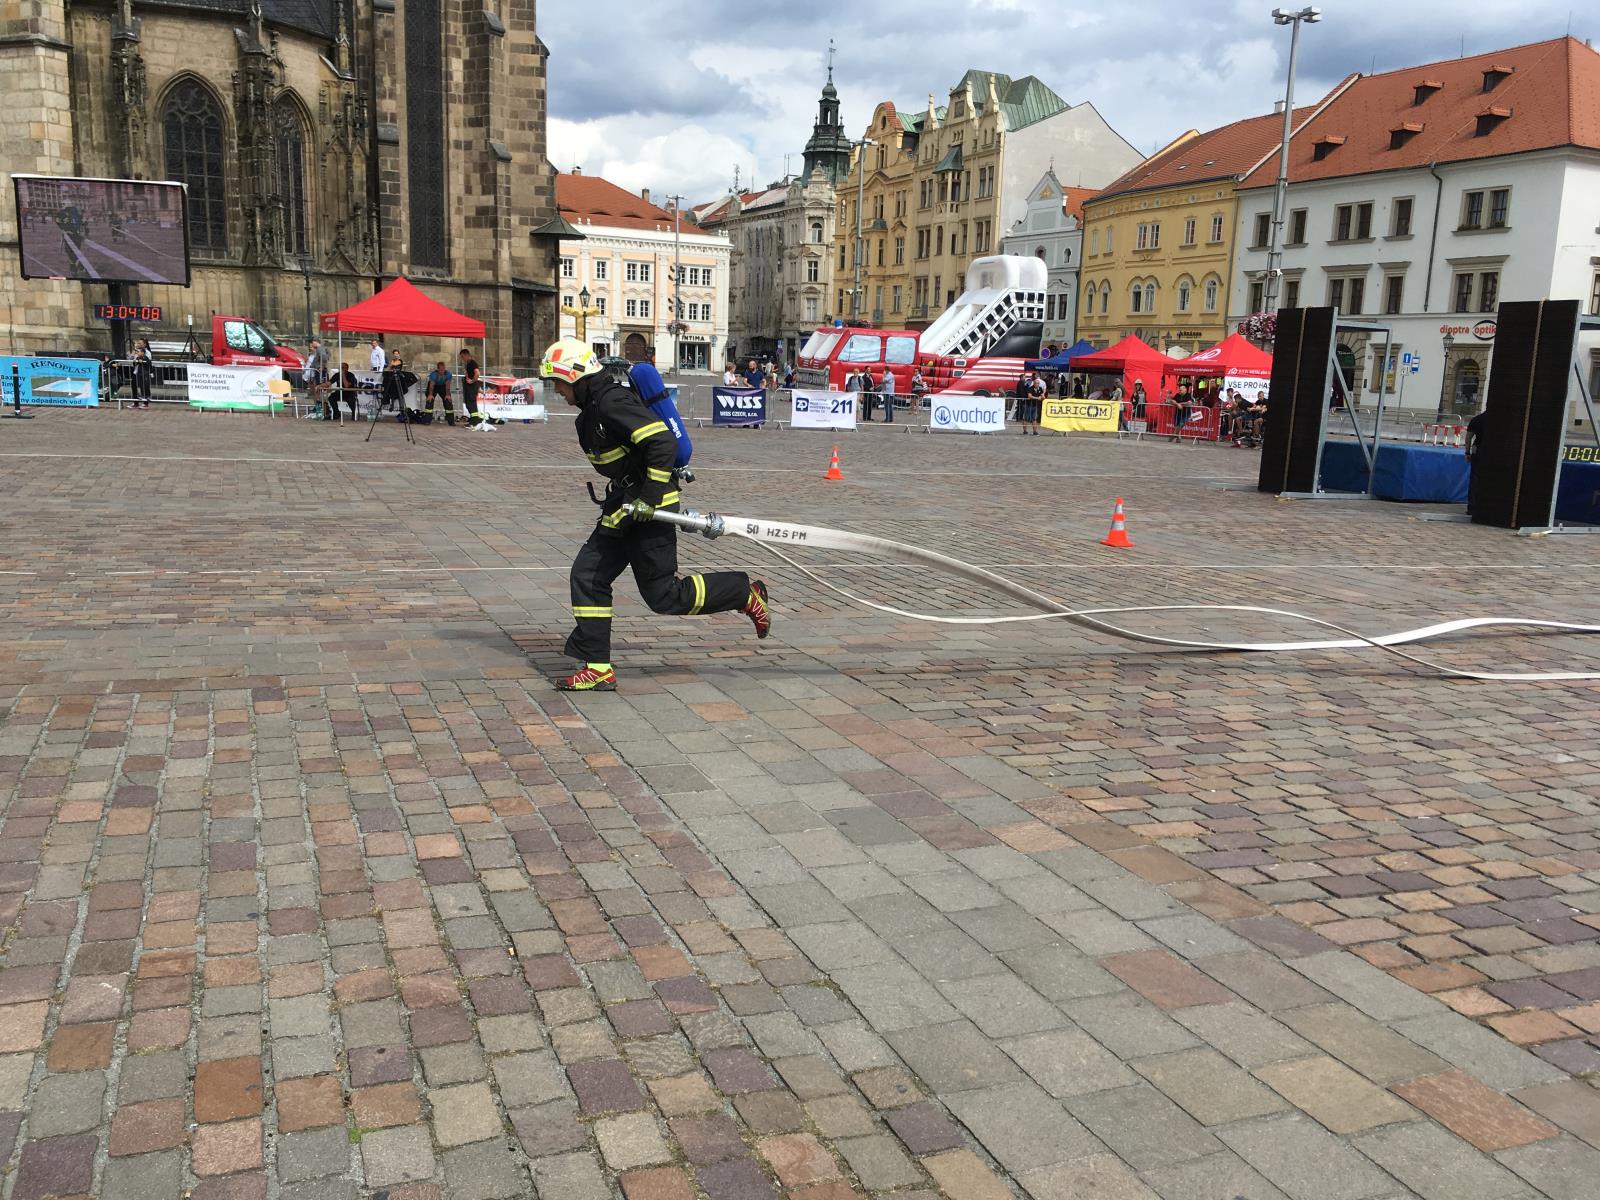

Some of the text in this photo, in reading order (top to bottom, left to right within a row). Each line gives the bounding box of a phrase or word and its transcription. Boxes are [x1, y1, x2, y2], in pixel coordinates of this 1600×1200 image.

[100, 306, 160, 320] 13:04:08
[1440, 326, 1470, 335] dioptra
[30, 360, 92, 374] RENOPLAST
[1228, 380, 1242, 388] VŠE
[716, 395, 762, 409] WISS
[831, 399, 852, 414] 211
[952, 407, 998, 423] vochoc
[1050, 405, 1107, 418] HARICOM
[746, 524, 806, 540] 50 HZS PM
